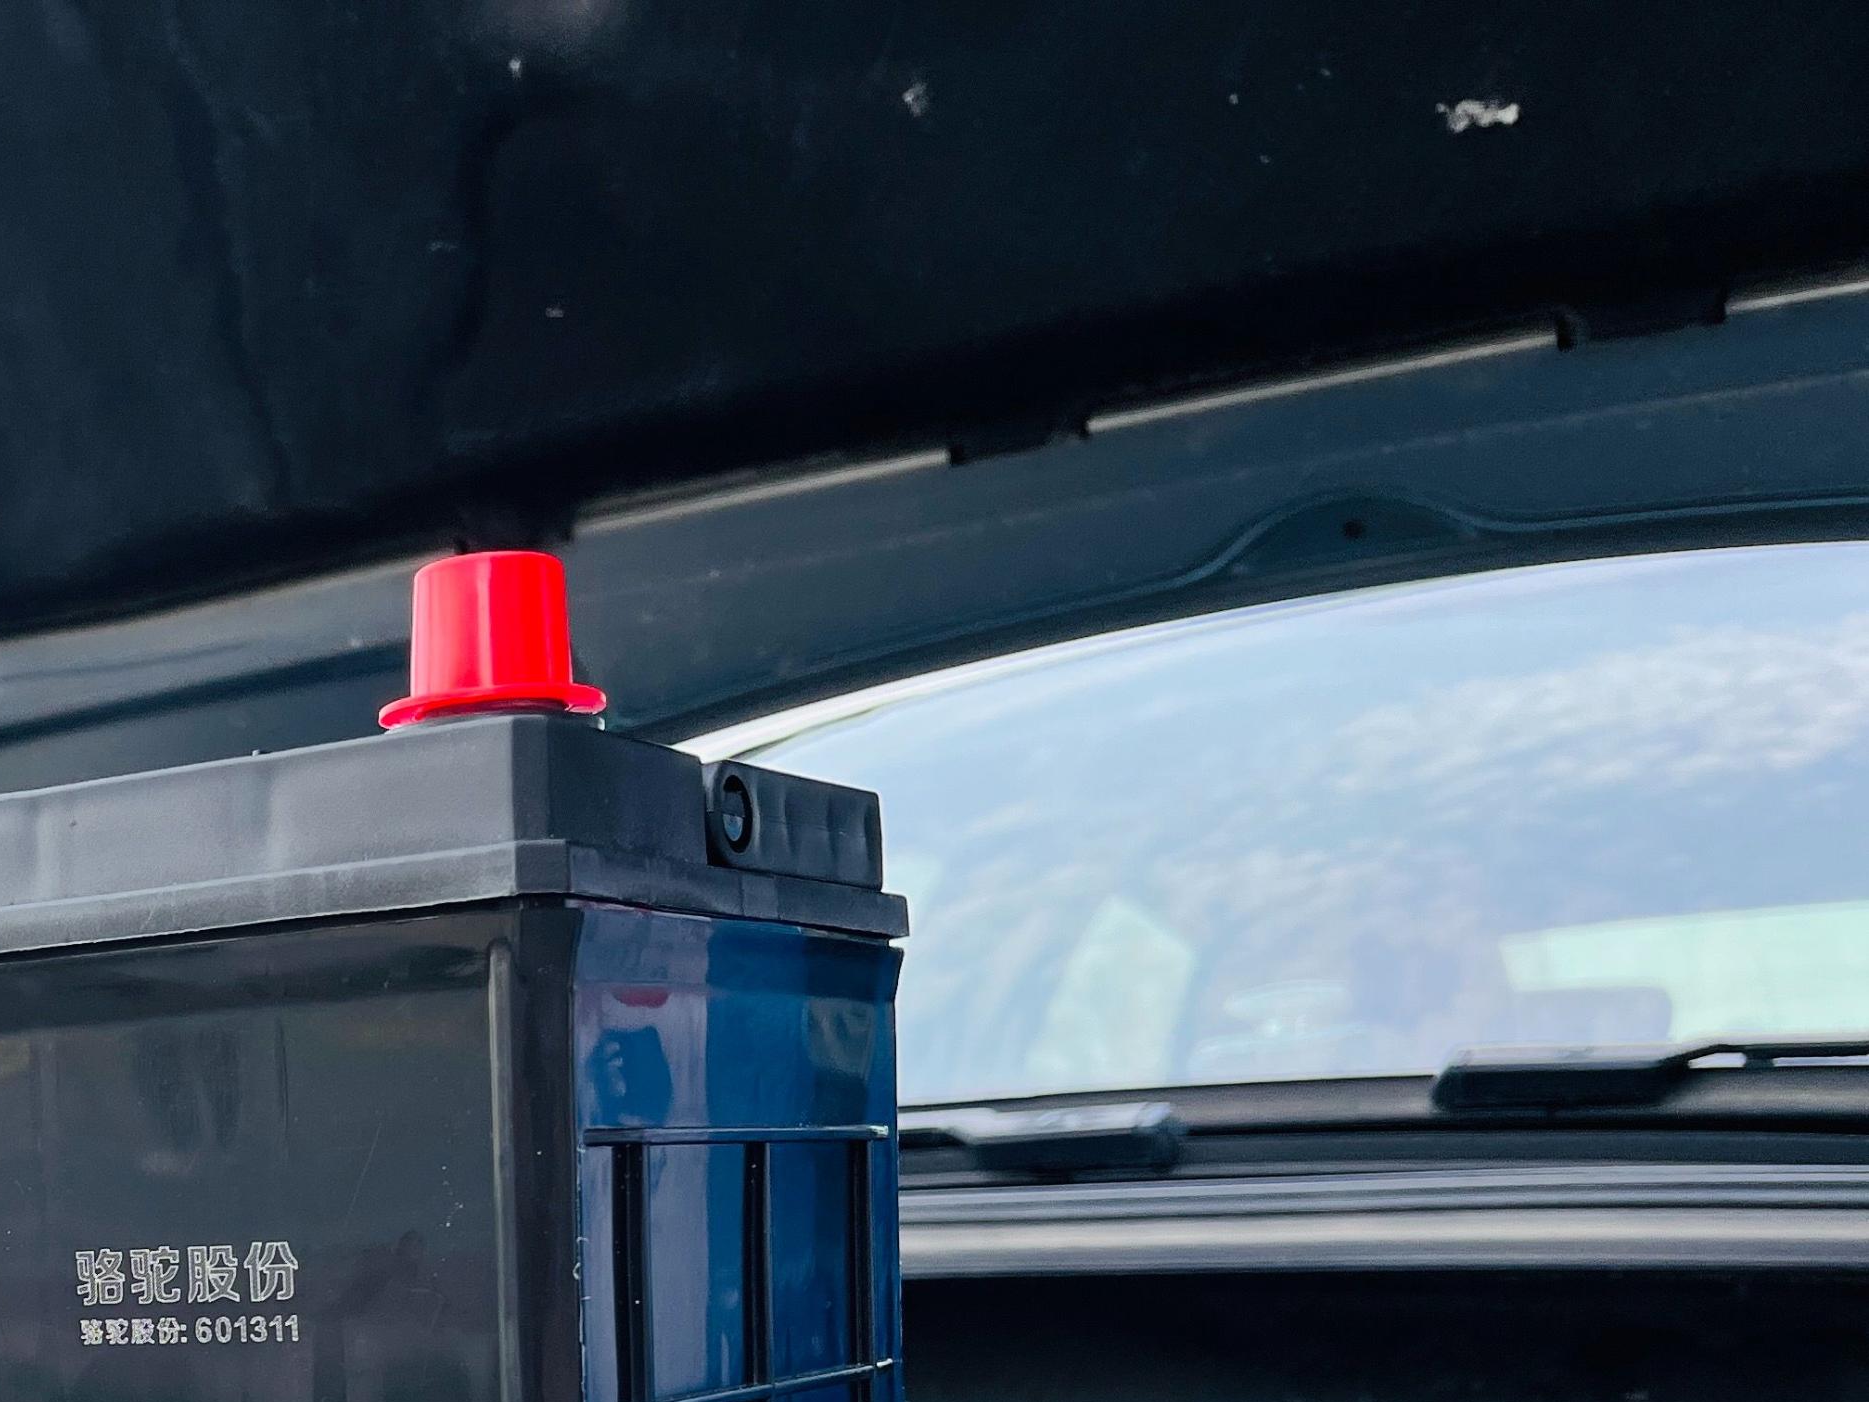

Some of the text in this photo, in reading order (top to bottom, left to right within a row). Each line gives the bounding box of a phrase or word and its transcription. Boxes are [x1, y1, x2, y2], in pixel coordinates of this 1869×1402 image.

[75, 1241, 298, 1306] 骆驼股份
[195, 1314, 299, 1344] 601311
